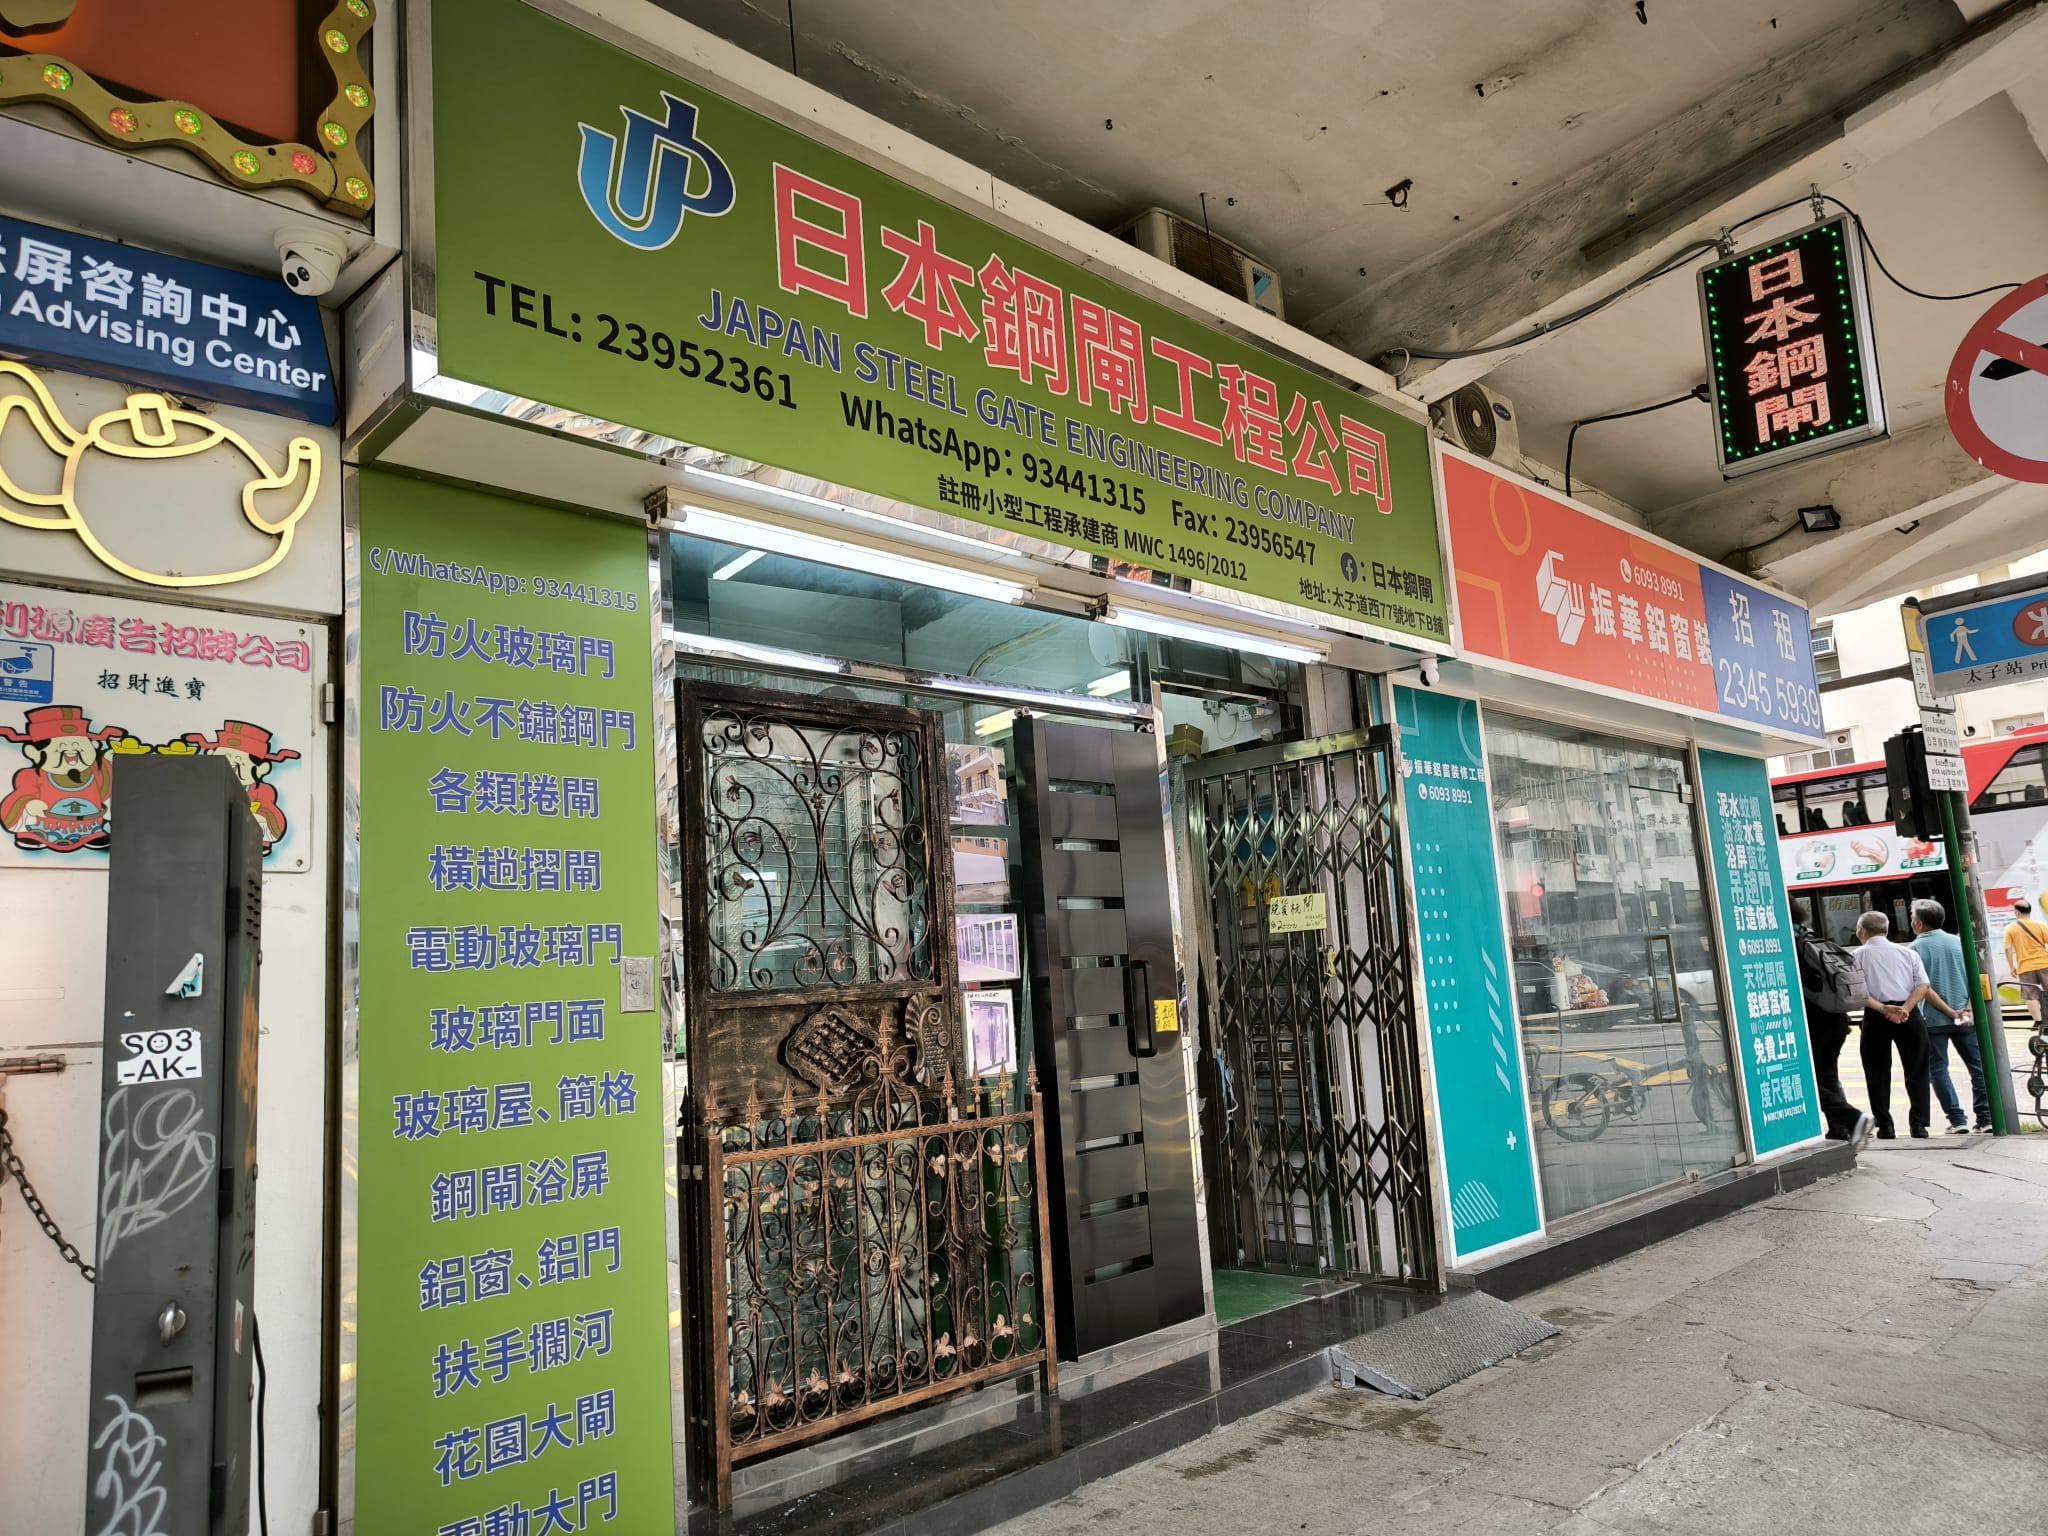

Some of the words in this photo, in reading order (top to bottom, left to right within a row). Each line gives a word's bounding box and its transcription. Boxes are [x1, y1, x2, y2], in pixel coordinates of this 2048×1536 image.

[0, 233, 302, 351] 屏咨詢中心
[11, 290, 195, 366] Advising
[205, 340, 326, 392] Center
[474, 271, 582, 342] TEL:
[597, 313, 797, 410] 23952361
[773, 162, 1393, 515] 日本鋼閘工程公司
[1743, 248, 1831, 444] 日本鋼閘
[697, 289, 841, 373] JAPAN
[854, 342, 968, 417] STEEL
[976, 388, 1058, 448] GATE
[1065, 417, 1249, 509] ENGINEERING
[1253, 485, 1356, 544] COMPANY
[841, 391, 1013, 476] WhatsApp:
[1022, 452, 1146, 515] 93441315
[1171, 500, 1218, 539] Fax:
[1225, 516, 1316, 566] 23956547
[937, 474, 1119, 549] 註冊小型工程承建商
[1124, 529, 1165, 560] MWC
[1168, 543, 1247, 582] 1496/2012
[532, 575, 638, 612] 93441315
[1633, 565, 1660, 592] 6093
[1660, 575, 1685, 602] 8991
[403, 610, 615, 679] 防火玻璃門
[1729, 589, 1797, 662] 招租
[97, 669, 206, 700] 招財進寶
[1719, 658, 1772, 716] 2345
[1776, 676, 1822, 730] 5939
[1964, 660, 2023, 684] 太子站
[379, 685, 636, 750] 防火不鏽鋼門
[428, 767, 600, 819] 各類捲閘
[1428, 785, 1450, 801] 6093
[1451, 788, 1473, 804] 8991
[428, 845, 602, 892] 橫趟摺閘
[406, 924, 623, 973] 電動玻璃門
[1746, 940, 1764, 954] 6093
[1764, 938, 1782, 953] 8991
[430, 999, 605, 1053] 玻璃門面
[1753, 1031, 1798, 1064] 免費上門
[393, 1070, 638, 1141] 玻璃屋、簡格
[431, 1150, 610, 1223] 鋼閘浴屏
[418, 1226, 622, 1312] 鋁窗、鋁門
[433, 1388, 615, 1487] 花園大閘
